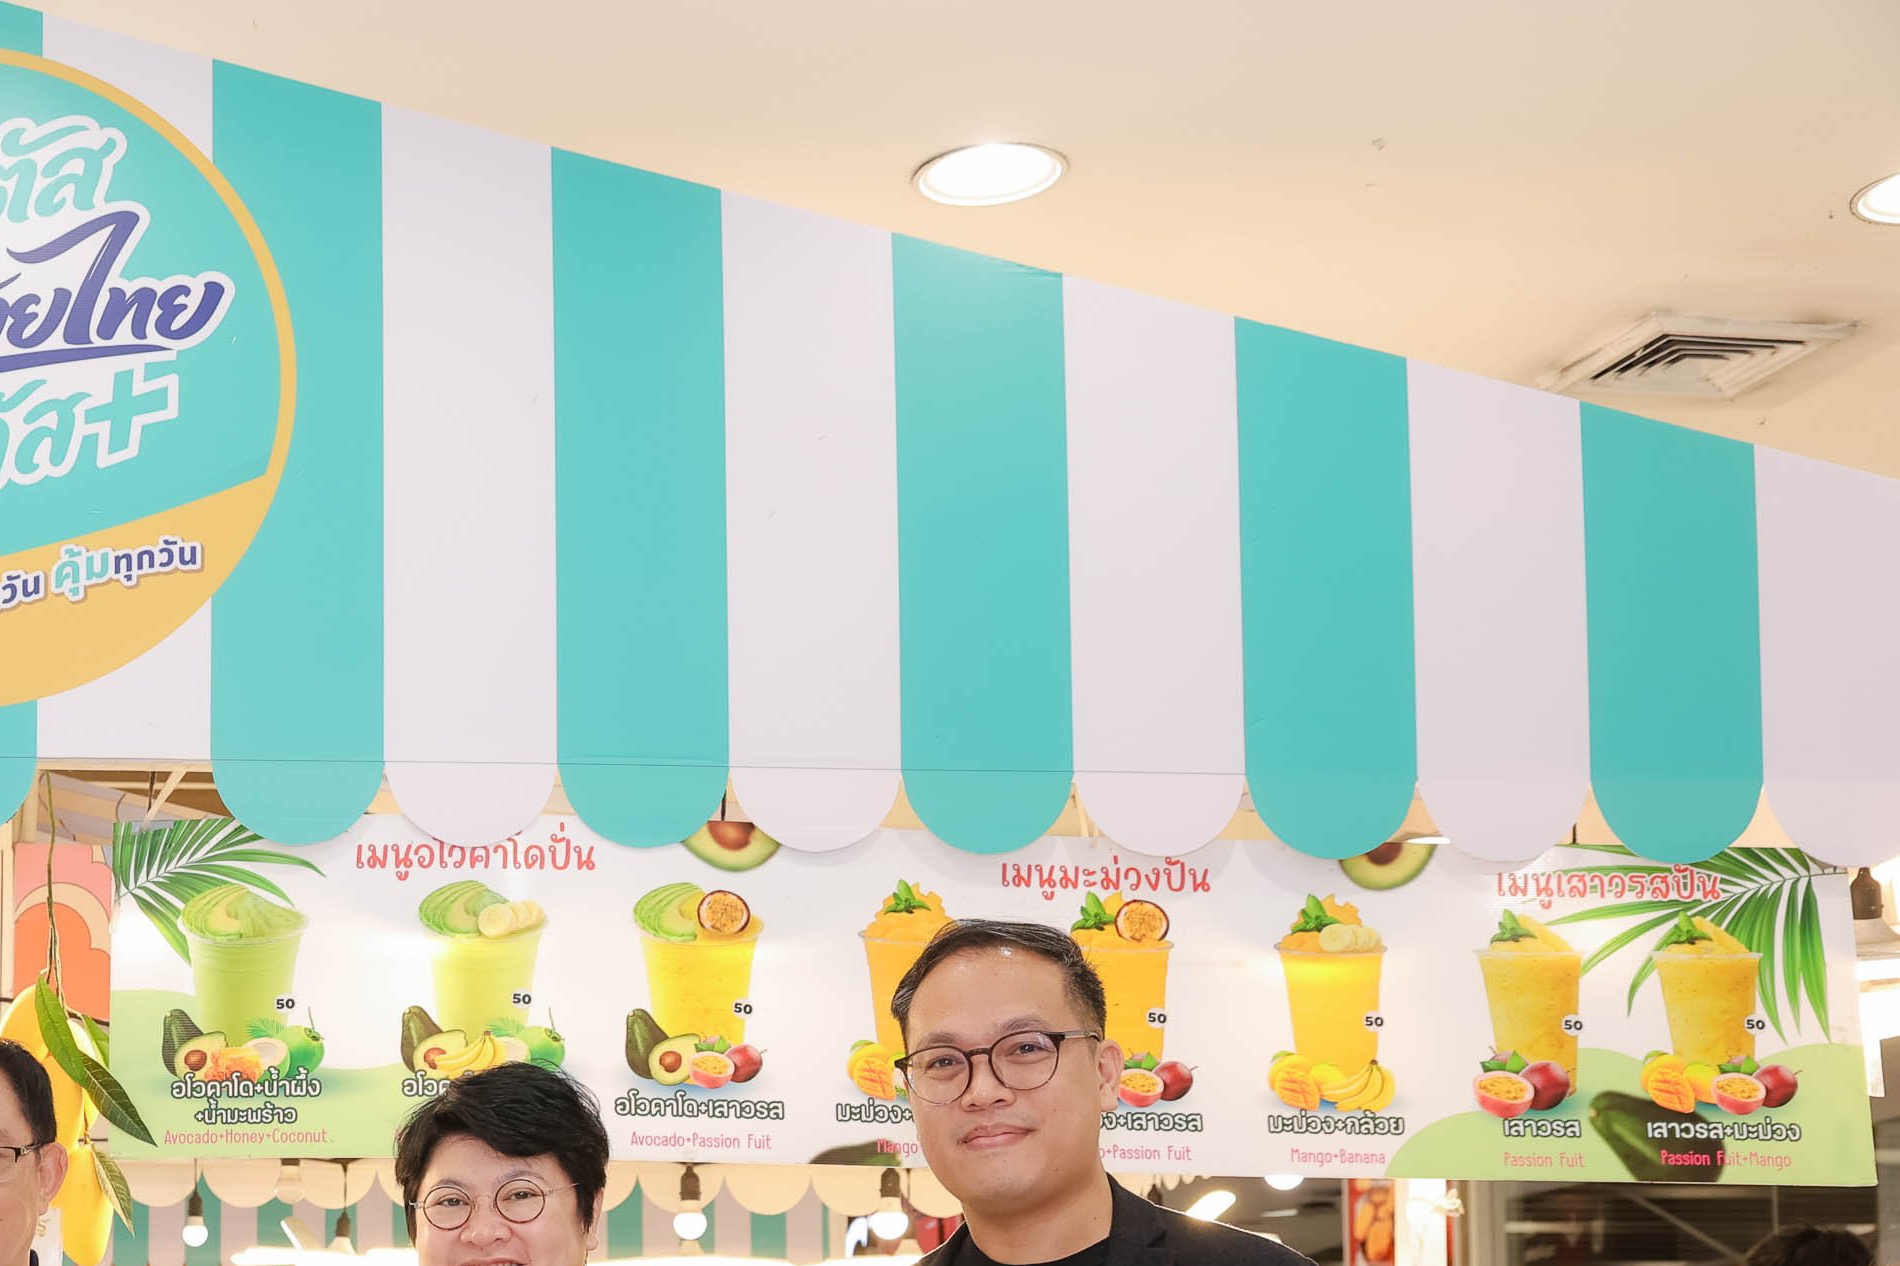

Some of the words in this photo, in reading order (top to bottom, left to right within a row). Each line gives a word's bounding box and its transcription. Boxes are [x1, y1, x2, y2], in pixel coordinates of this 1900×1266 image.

[52, 542, 198, 597] คุ้มทุกวัน
[1001, 855, 1211, 900] เมนูมะม่วงปัน
[1496, 863, 1722, 910] เมนูเสาวรสปัน
[276, 998, 295, 1010] 50
[512, 993, 532, 1005] 50
[734, 1003, 753, 1015] 50
[1147, 1012, 1167, 1024] 50
[1364, 1015, 1384, 1027] 50
[1563, 1019, 1583, 1031] 50
[1745, 1019, 1765, 1031] 50
[1503, 1118, 1582, 1138] เสาวรส
[164, 1128, 328, 1145] Avocado+Honey+Coconut
[630, 1131, 740, 1148] Avocado+Passion
[747, 1133, 773, 1149] Fuit
[876, 1138, 918, 1158] Mango
[1167, 1145, 1193, 1161] Fuit
[1291, 1148, 1386, 1167] Mango+Banana
[1504, 1151, 1553, 1168] Passion
[1660, 1150, 1711, 1166] Passion
